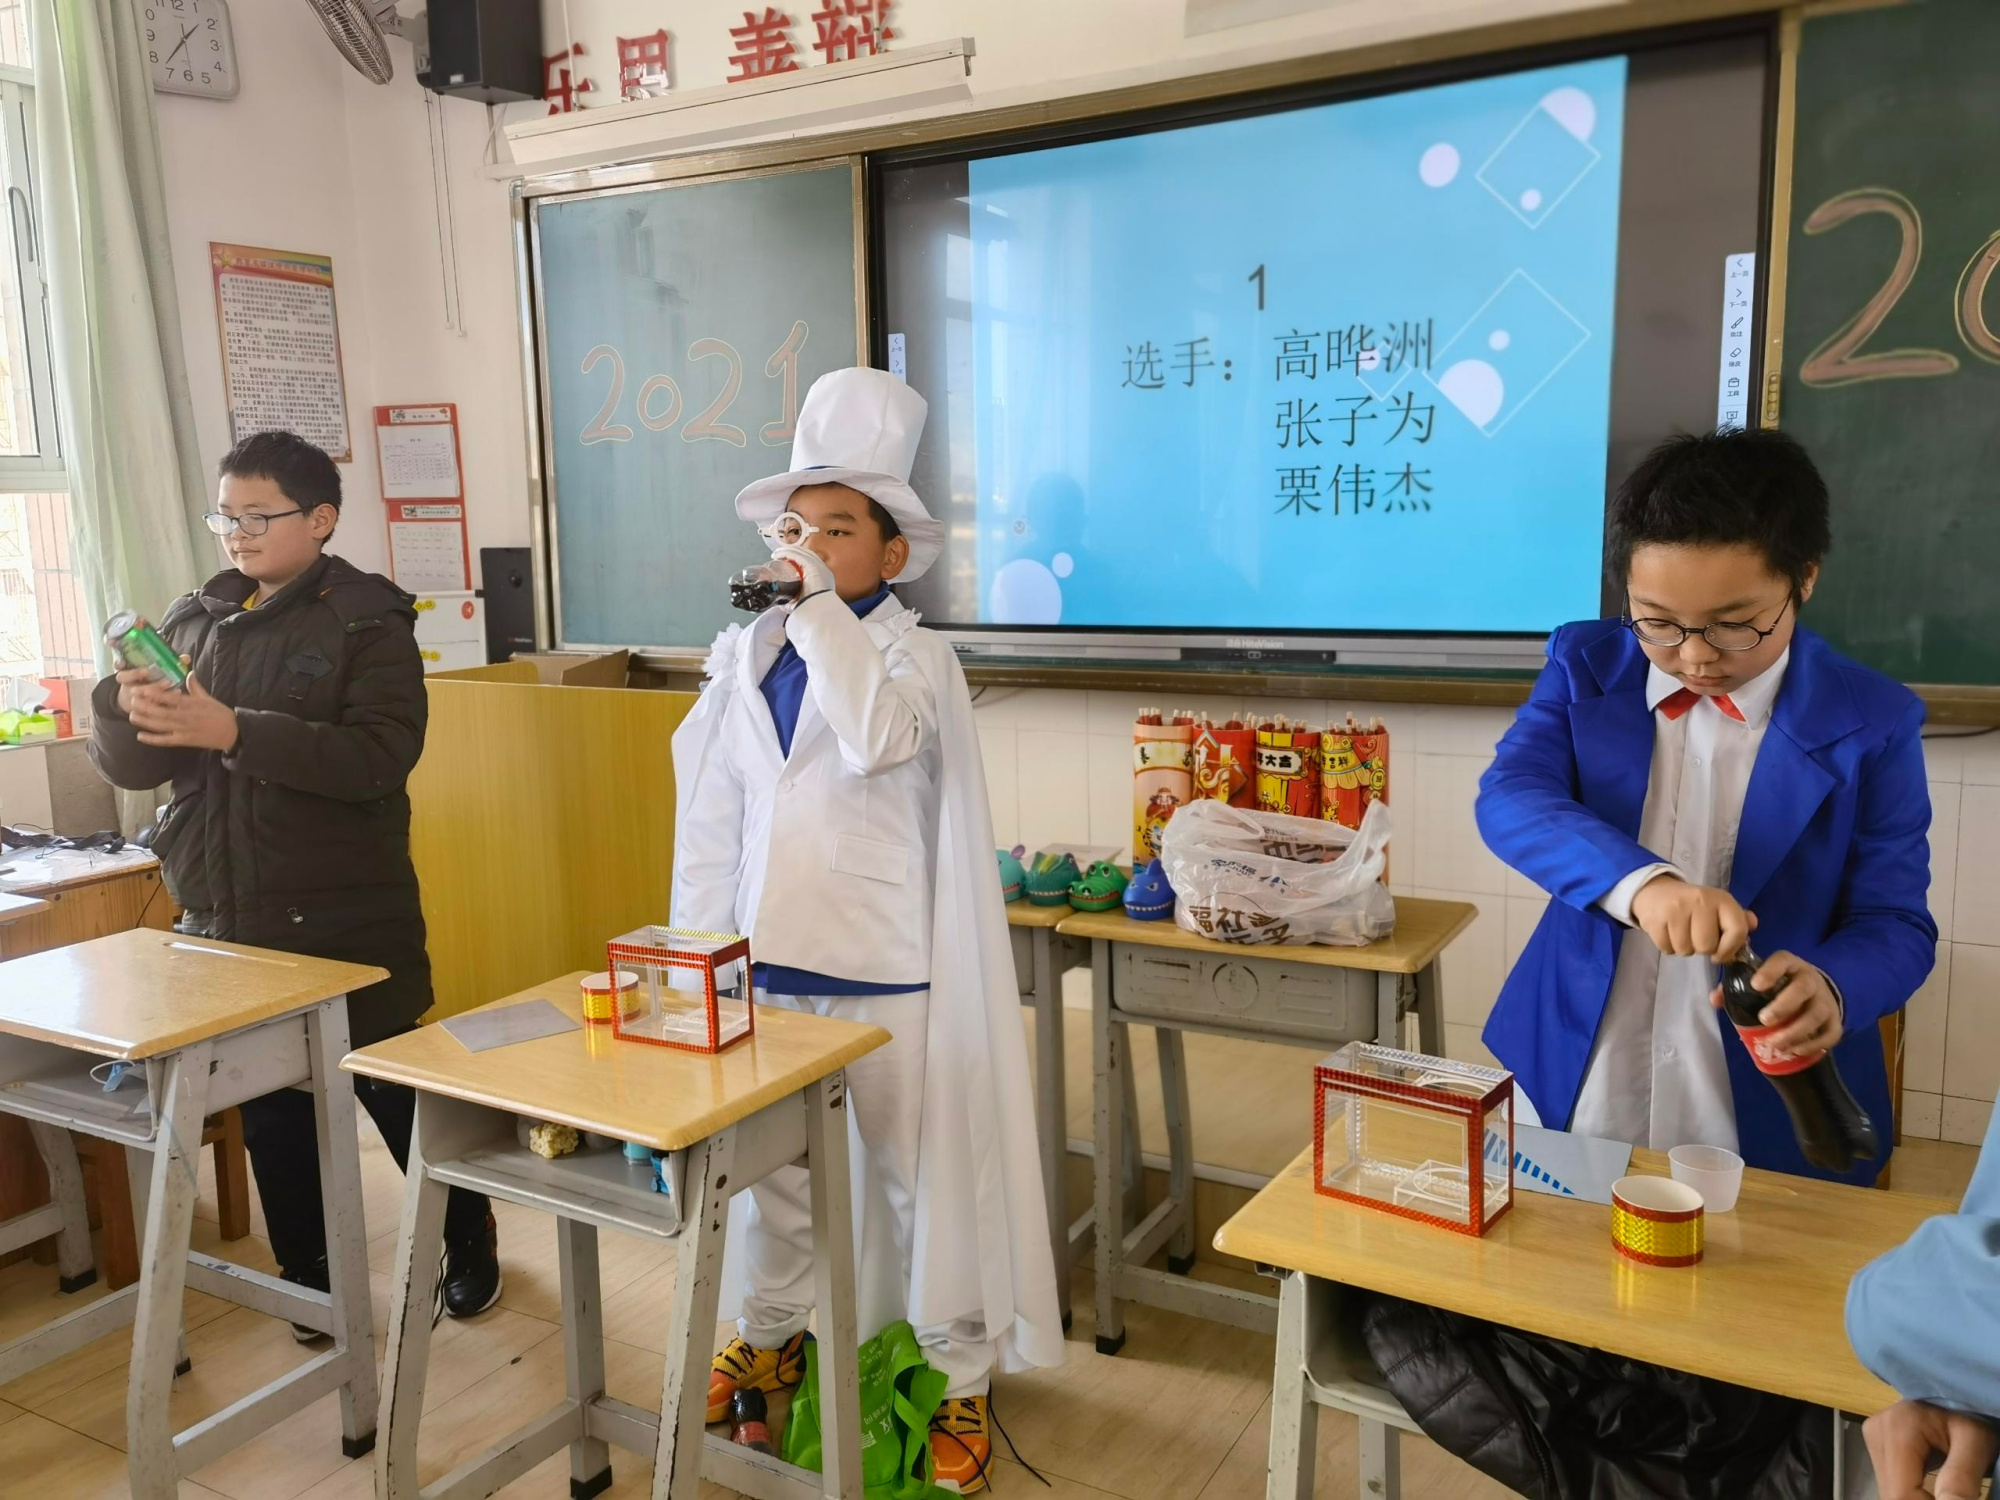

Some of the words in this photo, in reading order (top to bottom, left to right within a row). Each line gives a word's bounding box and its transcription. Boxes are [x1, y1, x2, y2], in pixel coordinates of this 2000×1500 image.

[206, 18, 216, 31] 2
[146, 29, 155, 42] 9
[210, 39, 219, 52] 3
[149, 51, 159, 64] 8
[165, 67, 175, 79] 7
[213, 61, 222, 72] 4
[183, 69, 194, 82] 6
[201, 72, 211, 84] 5
[1730, 270, 1749, 278] 上一页
[1248, 263, 1265, 311] 1
[1121, 336, 1232, 389] 选手：
[1273, 317, 1434, 382] 高晔洲
[579, 319, 809, 448] 2021
[1275, 390, 1436, 448] 张子为
[1273, 461, 1434, 516] 栗伟杰
